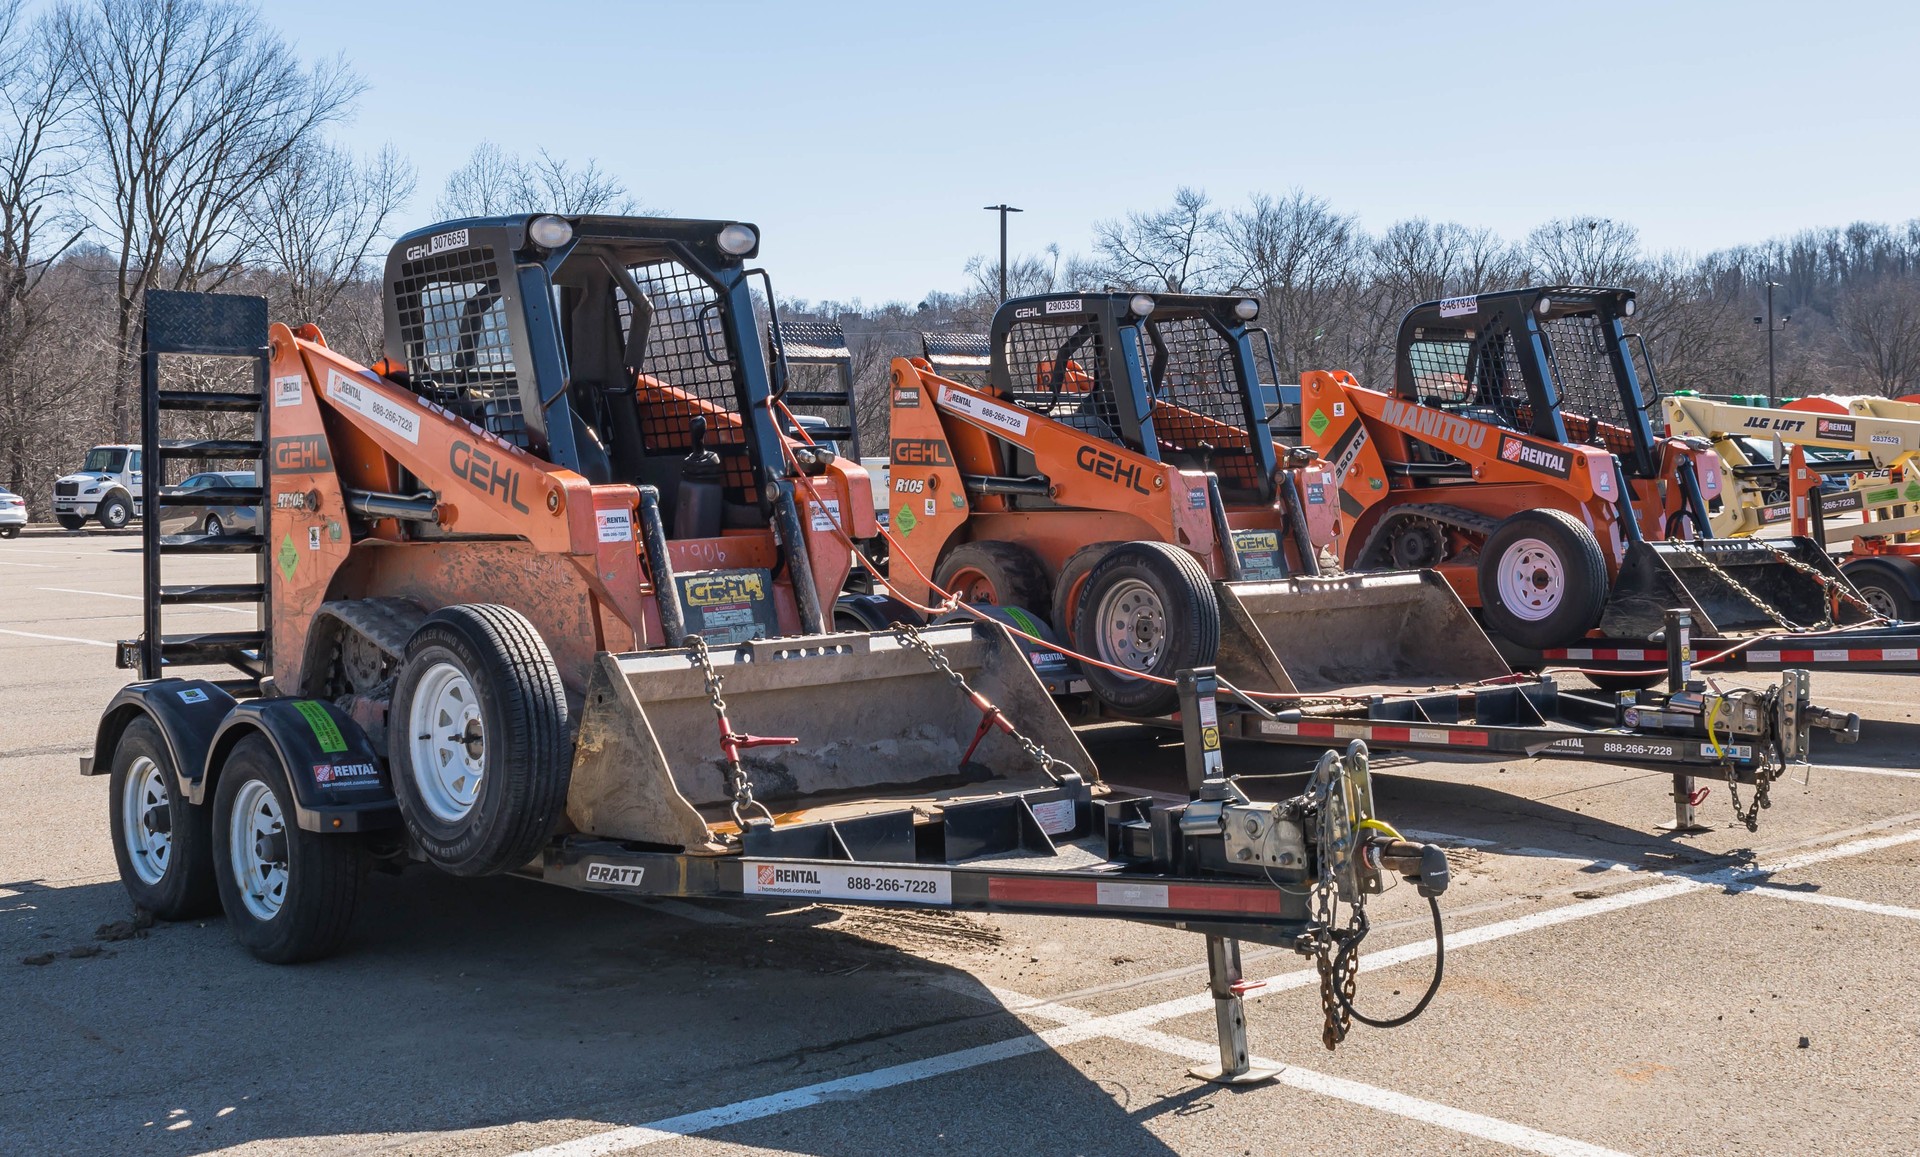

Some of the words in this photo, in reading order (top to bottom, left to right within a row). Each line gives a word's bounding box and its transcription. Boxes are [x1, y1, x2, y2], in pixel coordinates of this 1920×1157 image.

[433, 230, 466, 250] 3076659
[406, 243, 433, 261] GEHL
[1048, 300, 1079, 311] 2903358
[1441, 297, 1475, 311] 3487920
[1015, 307, 1041, 318] GEHL
[900, 391, 918, 400] RENTAL
[341, 381, 362, 401] RENTAL
[372, 402, 413, 432] 888-266-7228
[951, 394, 972, 408] RENTAL
[981, 407, 1021, 428] 888-266-7228
[1380, 400, 1488, 450] MANITOU
[1743, 416, 1771, 428] JLG
[1772, 419, 1806, 432] LIFT
[1828, 422, 1853, 432] RENTAL
[1353, 430, 1365, 450] RT
[1872, 435, 1899, 444] 2837529
[275, 440, 327, 469] GEHL
[895, 442, 946, 463] GEHL
[1520, 446, 1566, 472] RENTAL
[450, 440, 530, 516] GEHL
[1076, 445, 1150, 496] GEHL
[895, 479, 924, 494] R105
[606, 516, 629, 524] RENTAL
[1236, 536, 1275, 550] GEHL
[408, 628, 437, 652] TRAILER
[438, 629, 458, 647] KING
[1040, 652, 1066, 662] RENTAL
[1604, 742, 1673, 756] 888-266-7228
[333, 763, 378, 777] RENTAL
[589, 866, 642, 884] PRATT
[776, 869, 821, 884] RENTAL
[762, 886, 822, 895] homedepot.com/rental
[847, 876, 937, 894] 888-266-7228
